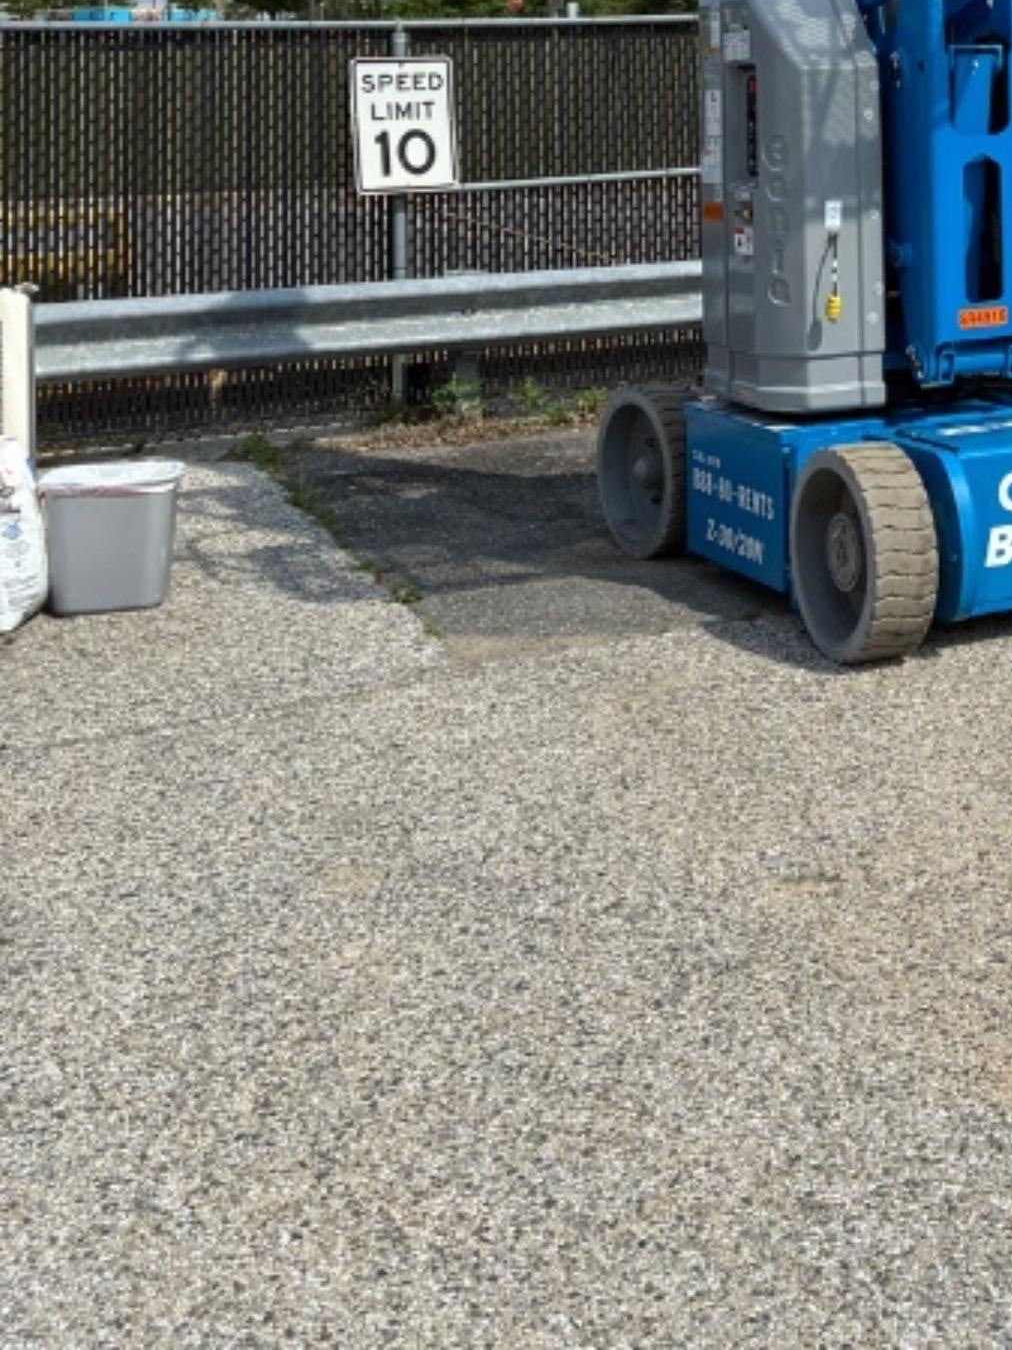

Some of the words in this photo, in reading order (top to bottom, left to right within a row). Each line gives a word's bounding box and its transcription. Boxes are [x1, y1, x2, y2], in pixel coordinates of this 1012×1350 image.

[361, 72, 444, 94] SPEED
[370, 100, 436, 121] LIMIT
[374, 127, 437, 178] 10
